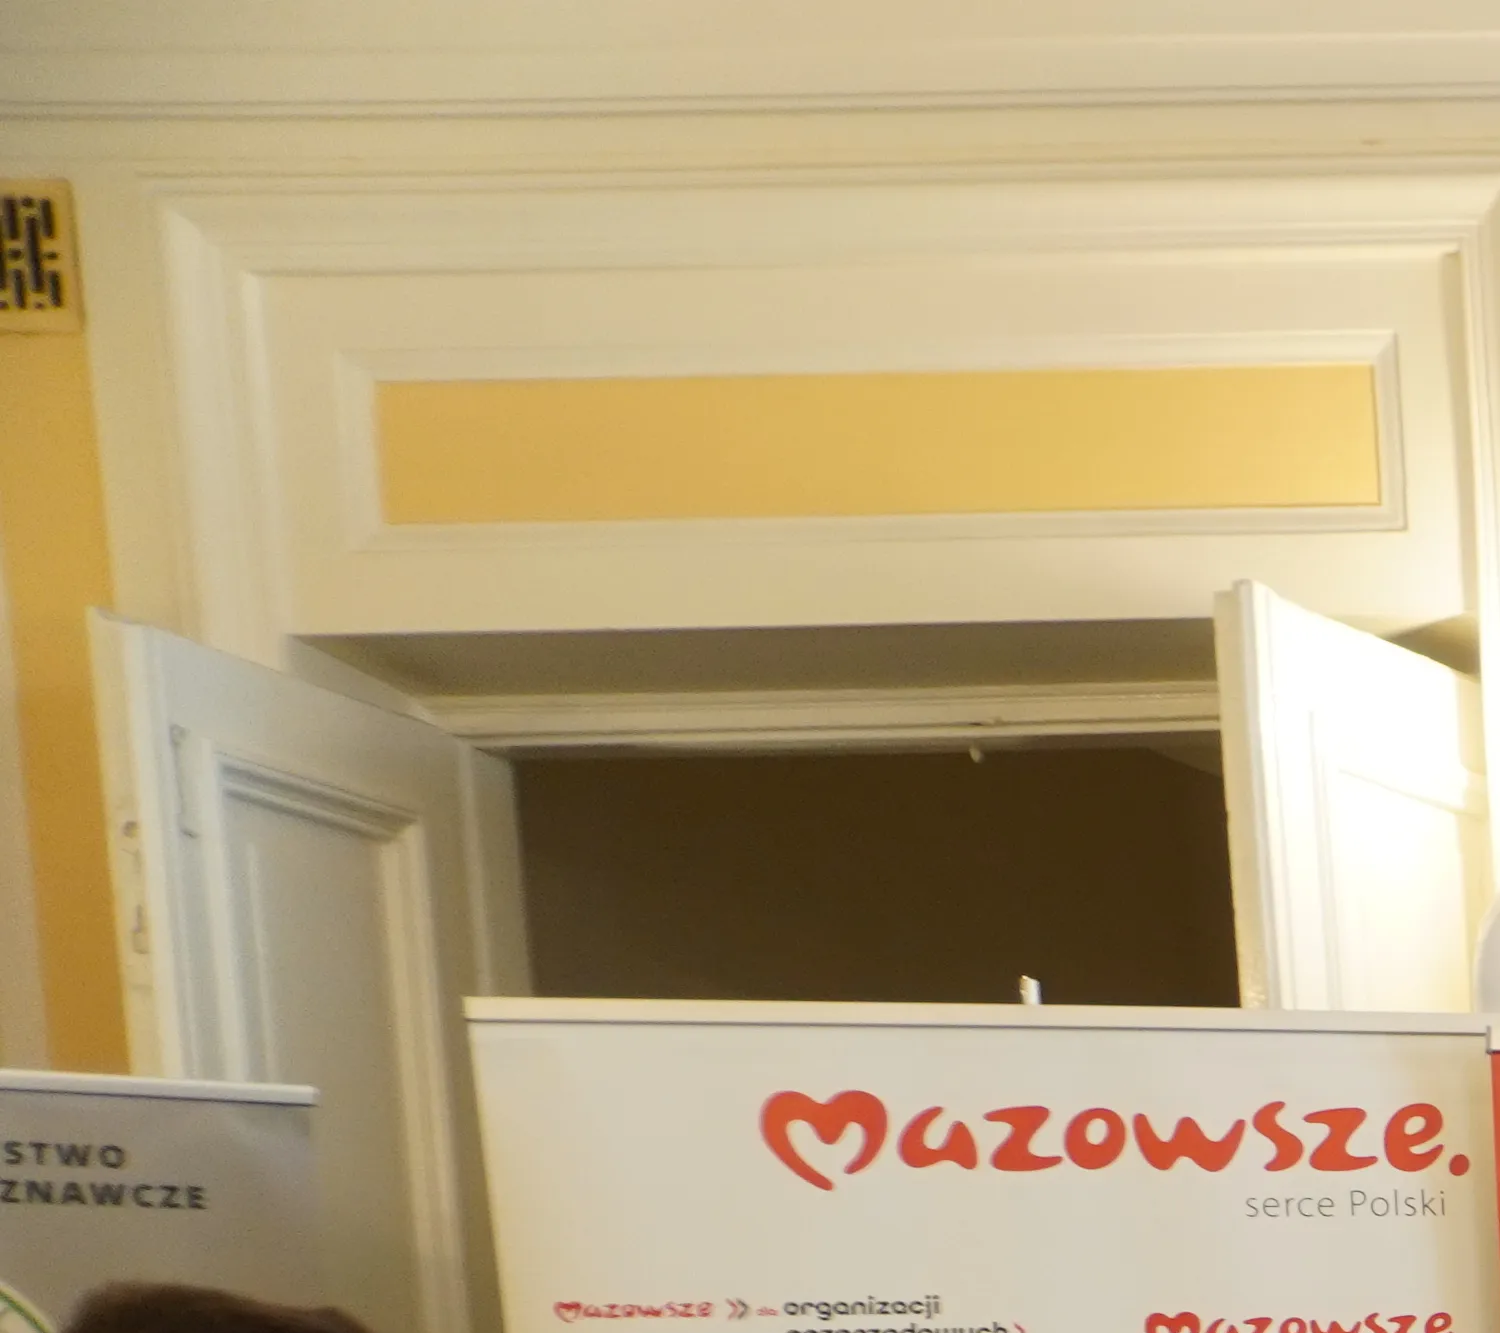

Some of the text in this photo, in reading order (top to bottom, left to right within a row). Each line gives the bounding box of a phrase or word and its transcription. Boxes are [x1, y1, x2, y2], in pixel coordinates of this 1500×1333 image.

[1245, 1189, 1446, 1218] serce Polski
[783, 1295, 942, 1320] organizacji
